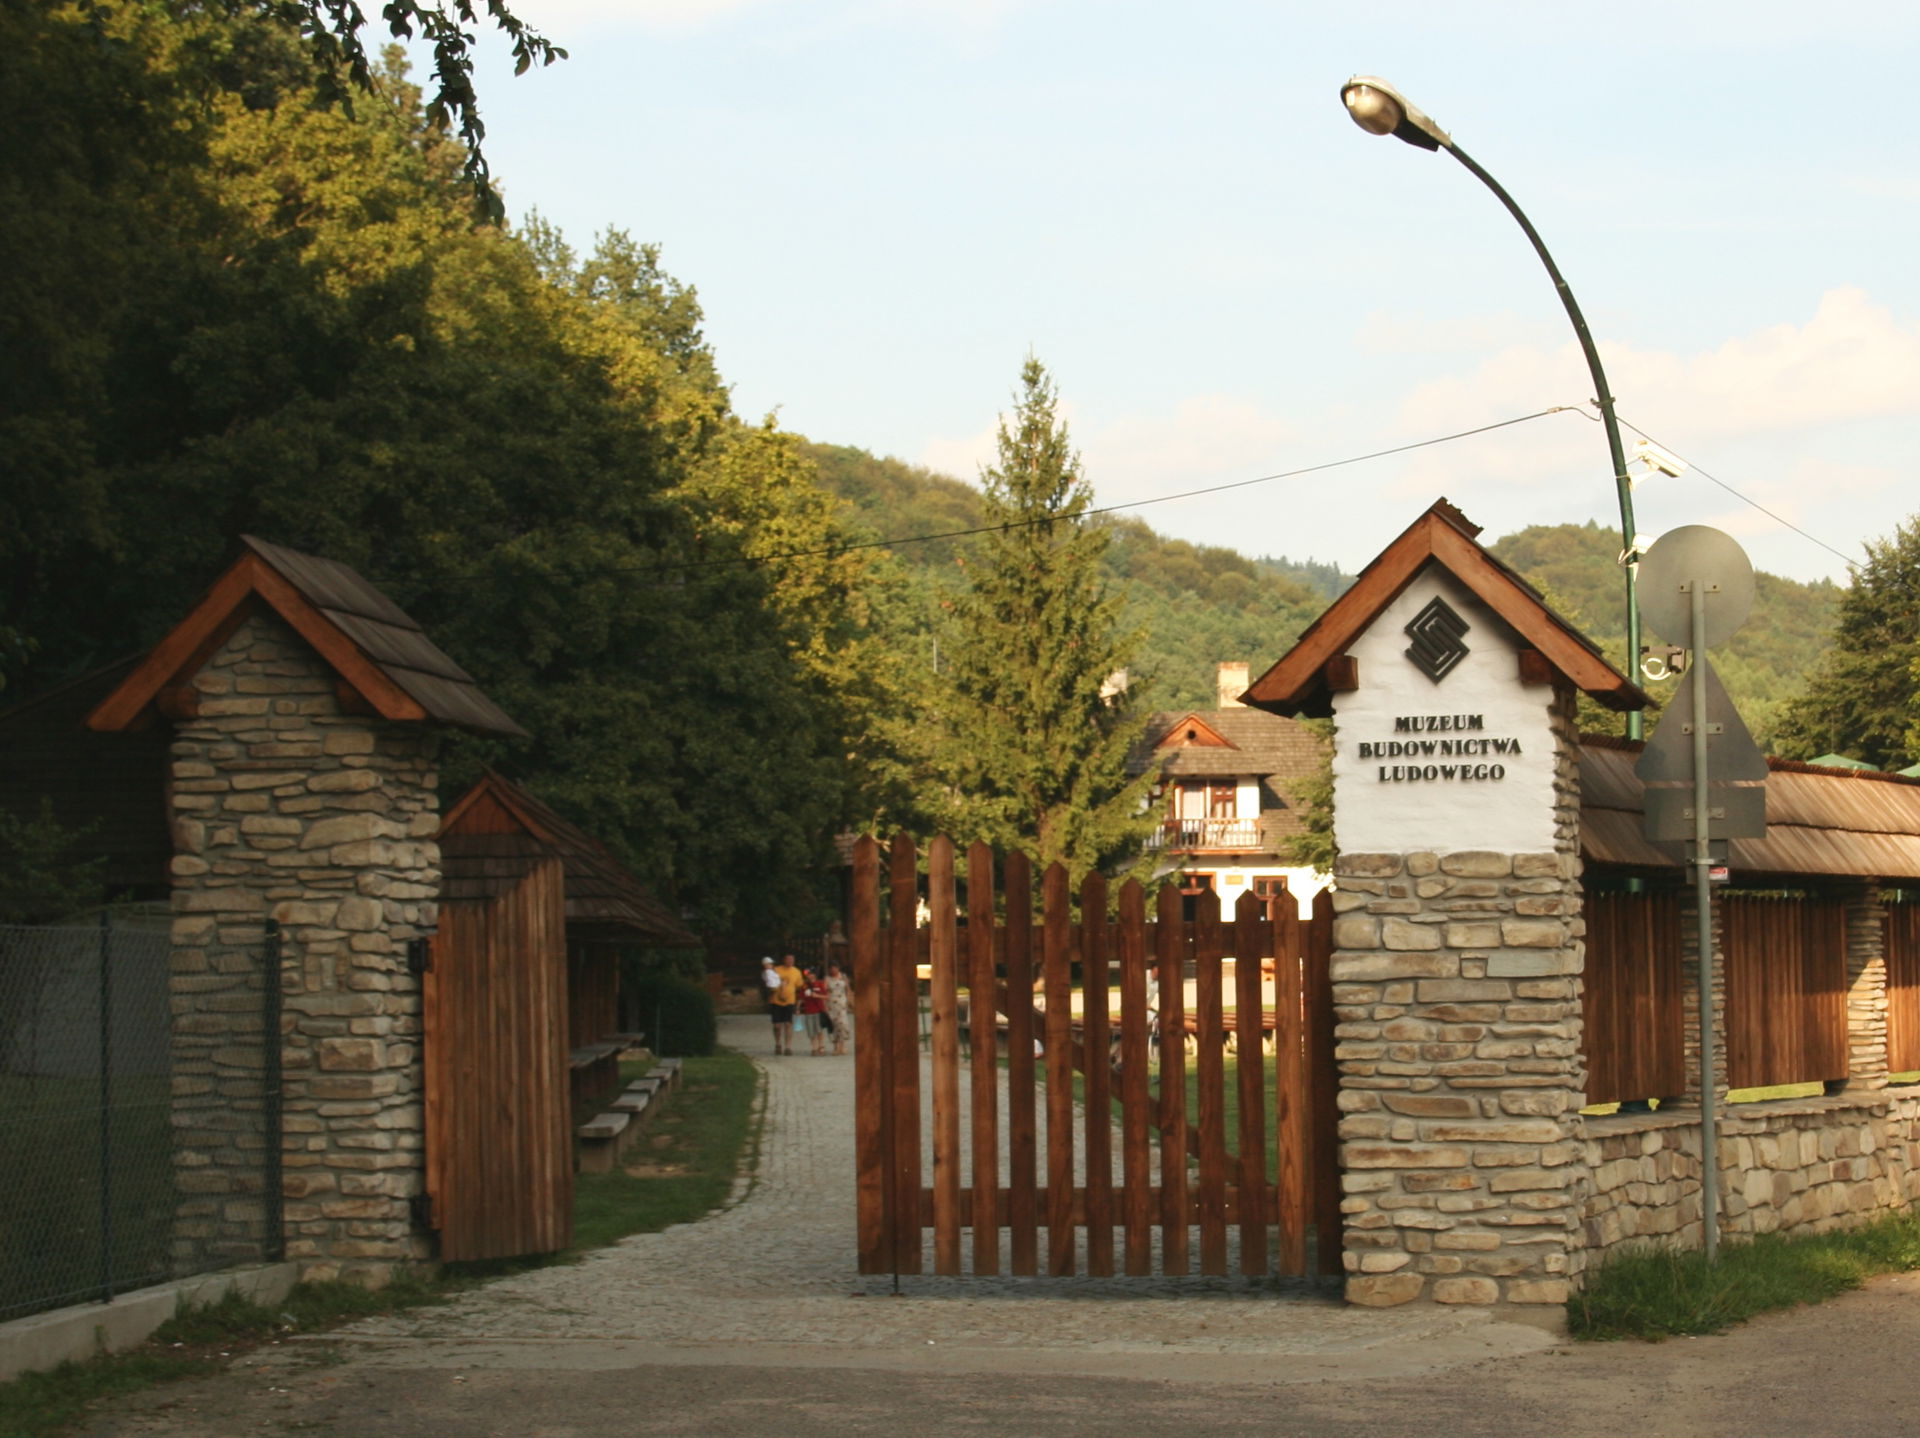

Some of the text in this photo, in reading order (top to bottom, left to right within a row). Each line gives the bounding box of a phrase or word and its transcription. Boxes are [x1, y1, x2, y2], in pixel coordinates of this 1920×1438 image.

[1394, 714, 1484, 733] MUZEUM
[1358, 738, 1522, 759] BUDOWNICTWA
[1377, 764, 1506, 782] LUDOWEGO
